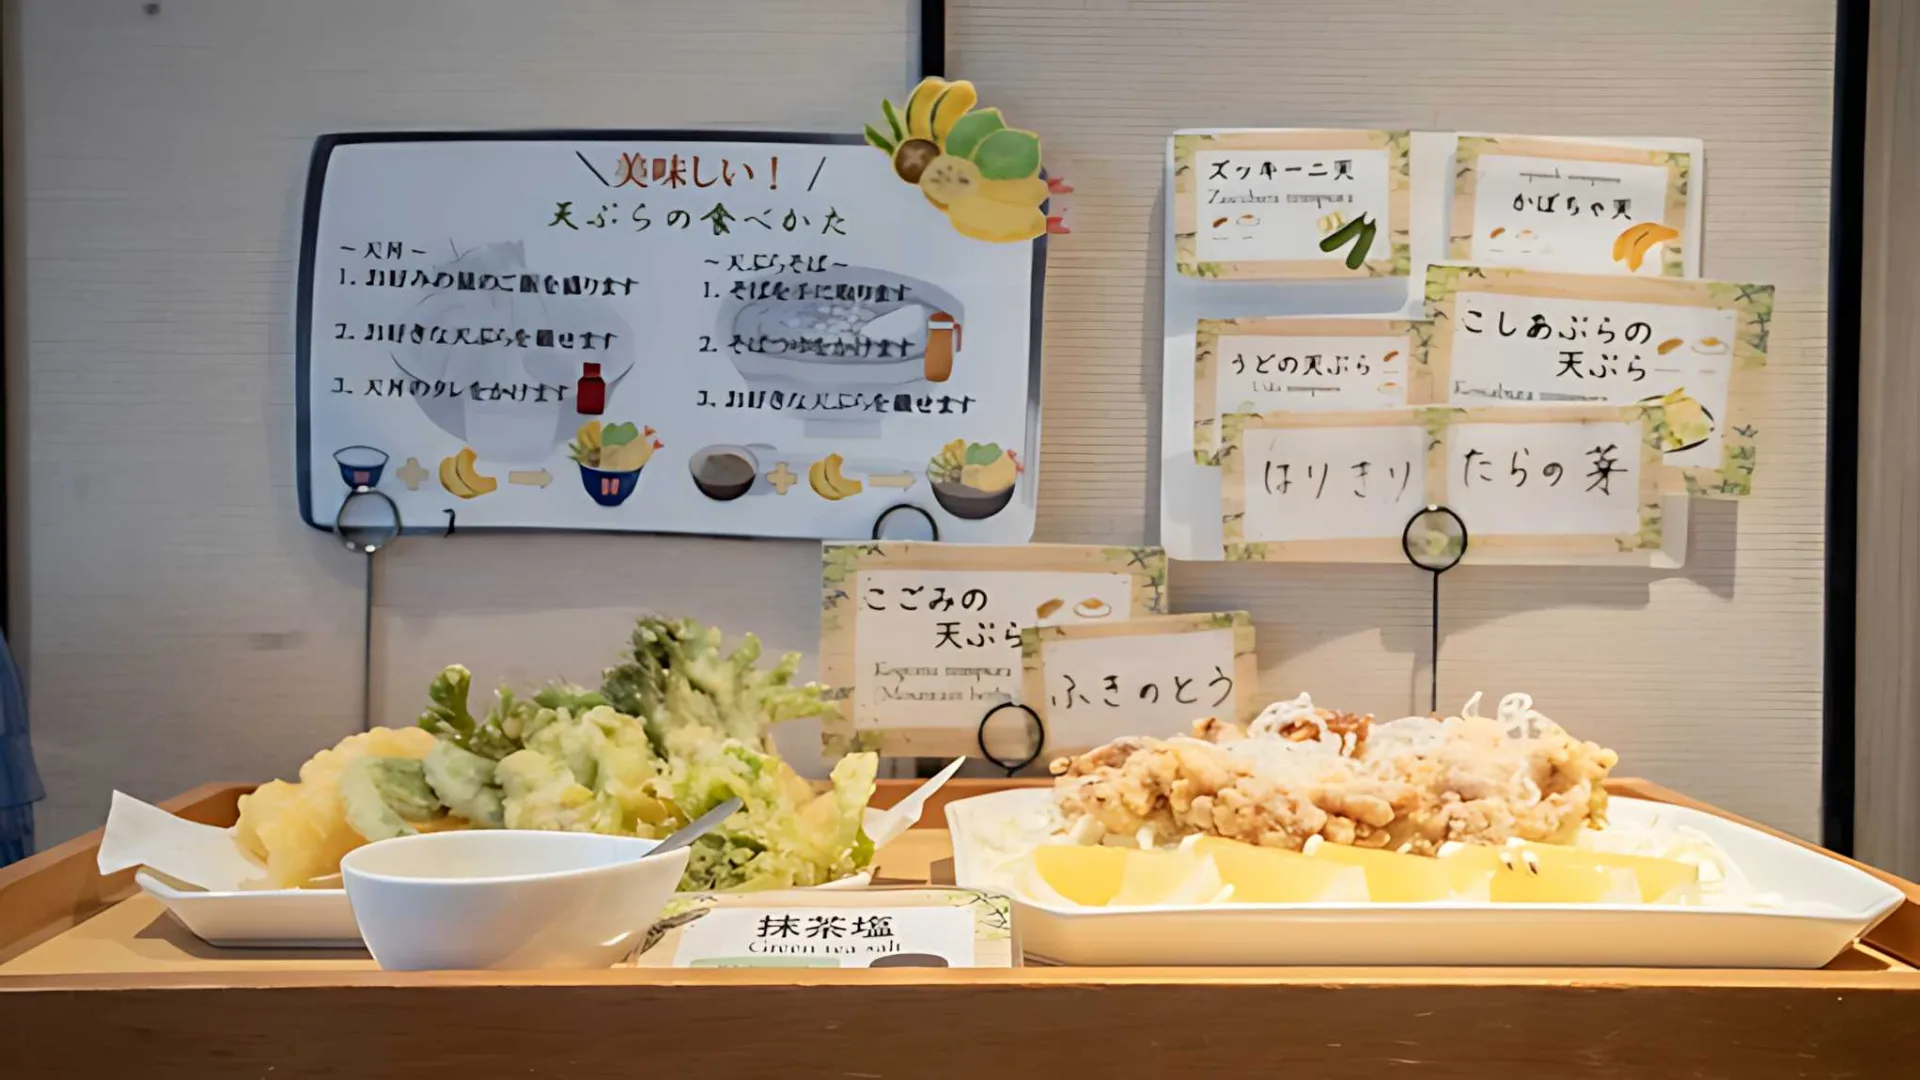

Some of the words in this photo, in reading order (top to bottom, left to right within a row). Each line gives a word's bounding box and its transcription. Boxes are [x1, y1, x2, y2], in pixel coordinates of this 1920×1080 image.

[548, 201, 848, 236] 天ぷらの食べかた
[1460, 310, 1653, 346] こしあぶらの
[862, 584, 988, 612] こごみの
[1050, 664, 1234, 710] ふきのとう
